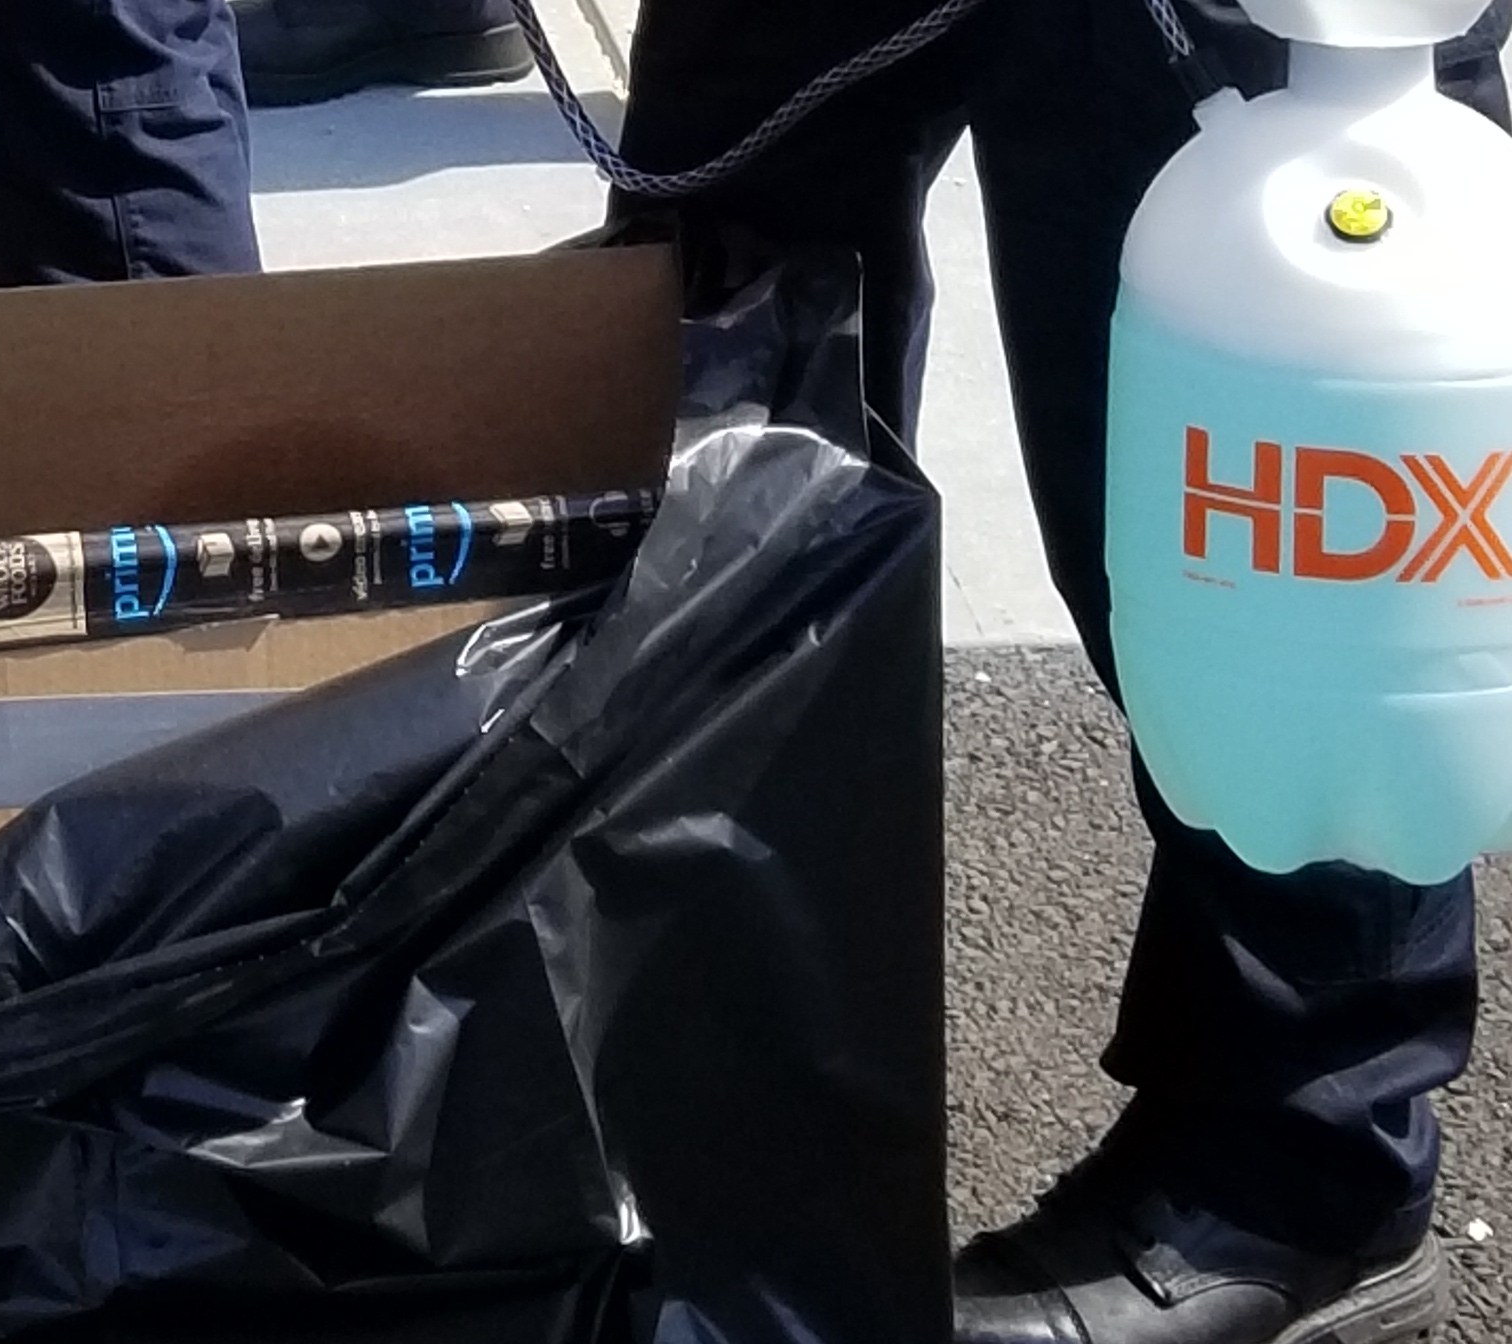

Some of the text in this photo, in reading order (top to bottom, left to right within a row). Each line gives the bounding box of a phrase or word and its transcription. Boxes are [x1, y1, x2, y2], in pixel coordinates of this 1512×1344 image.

[399, 505, 445, 588] prim
[1184, 424, 1512, 584] HDX
[9, 542, 29, 606] FOODS
[104, 525, 150, 620] prim
